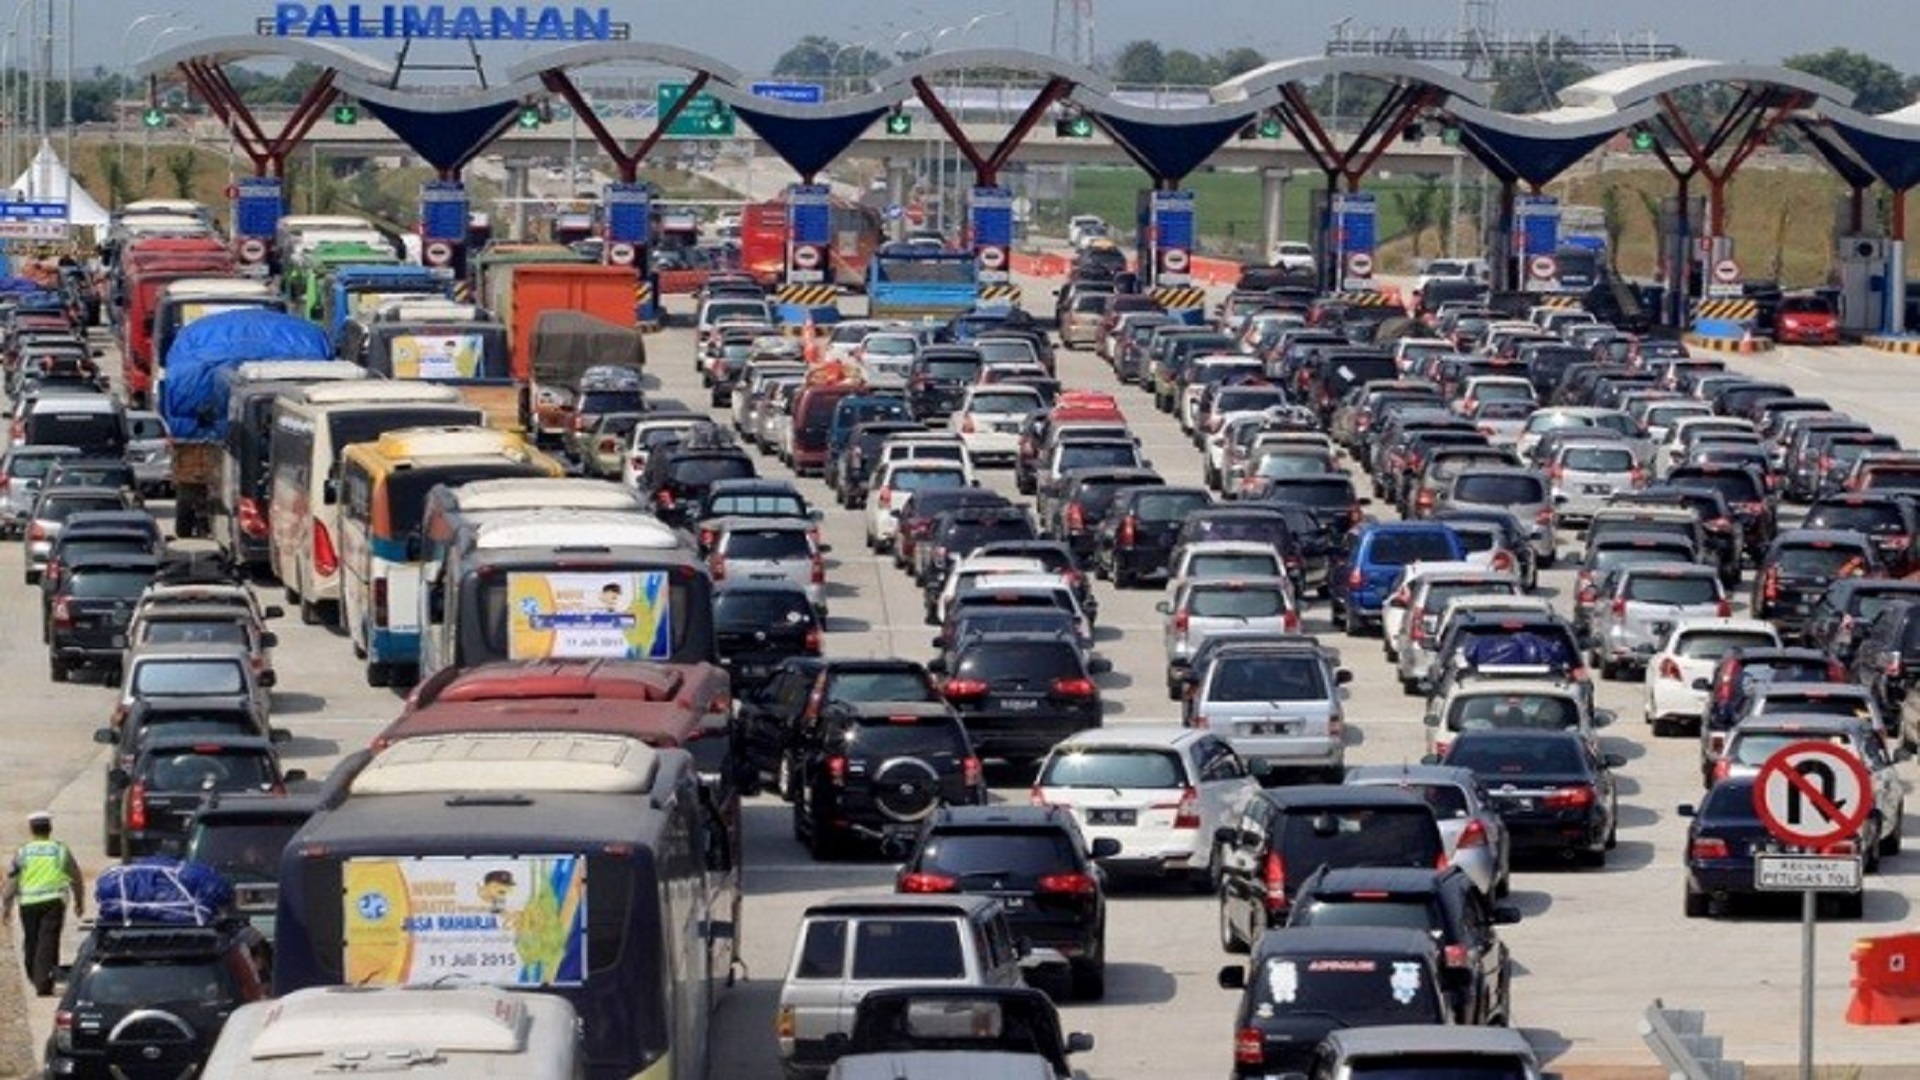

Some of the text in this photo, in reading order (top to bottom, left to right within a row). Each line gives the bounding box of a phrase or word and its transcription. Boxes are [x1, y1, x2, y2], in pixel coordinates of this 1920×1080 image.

[275, 3, 610, 39] PALIMANAN
[438, 915, 498, 931] RAHARJA
[429, 953, 517, 968] 11 Juli 2015
